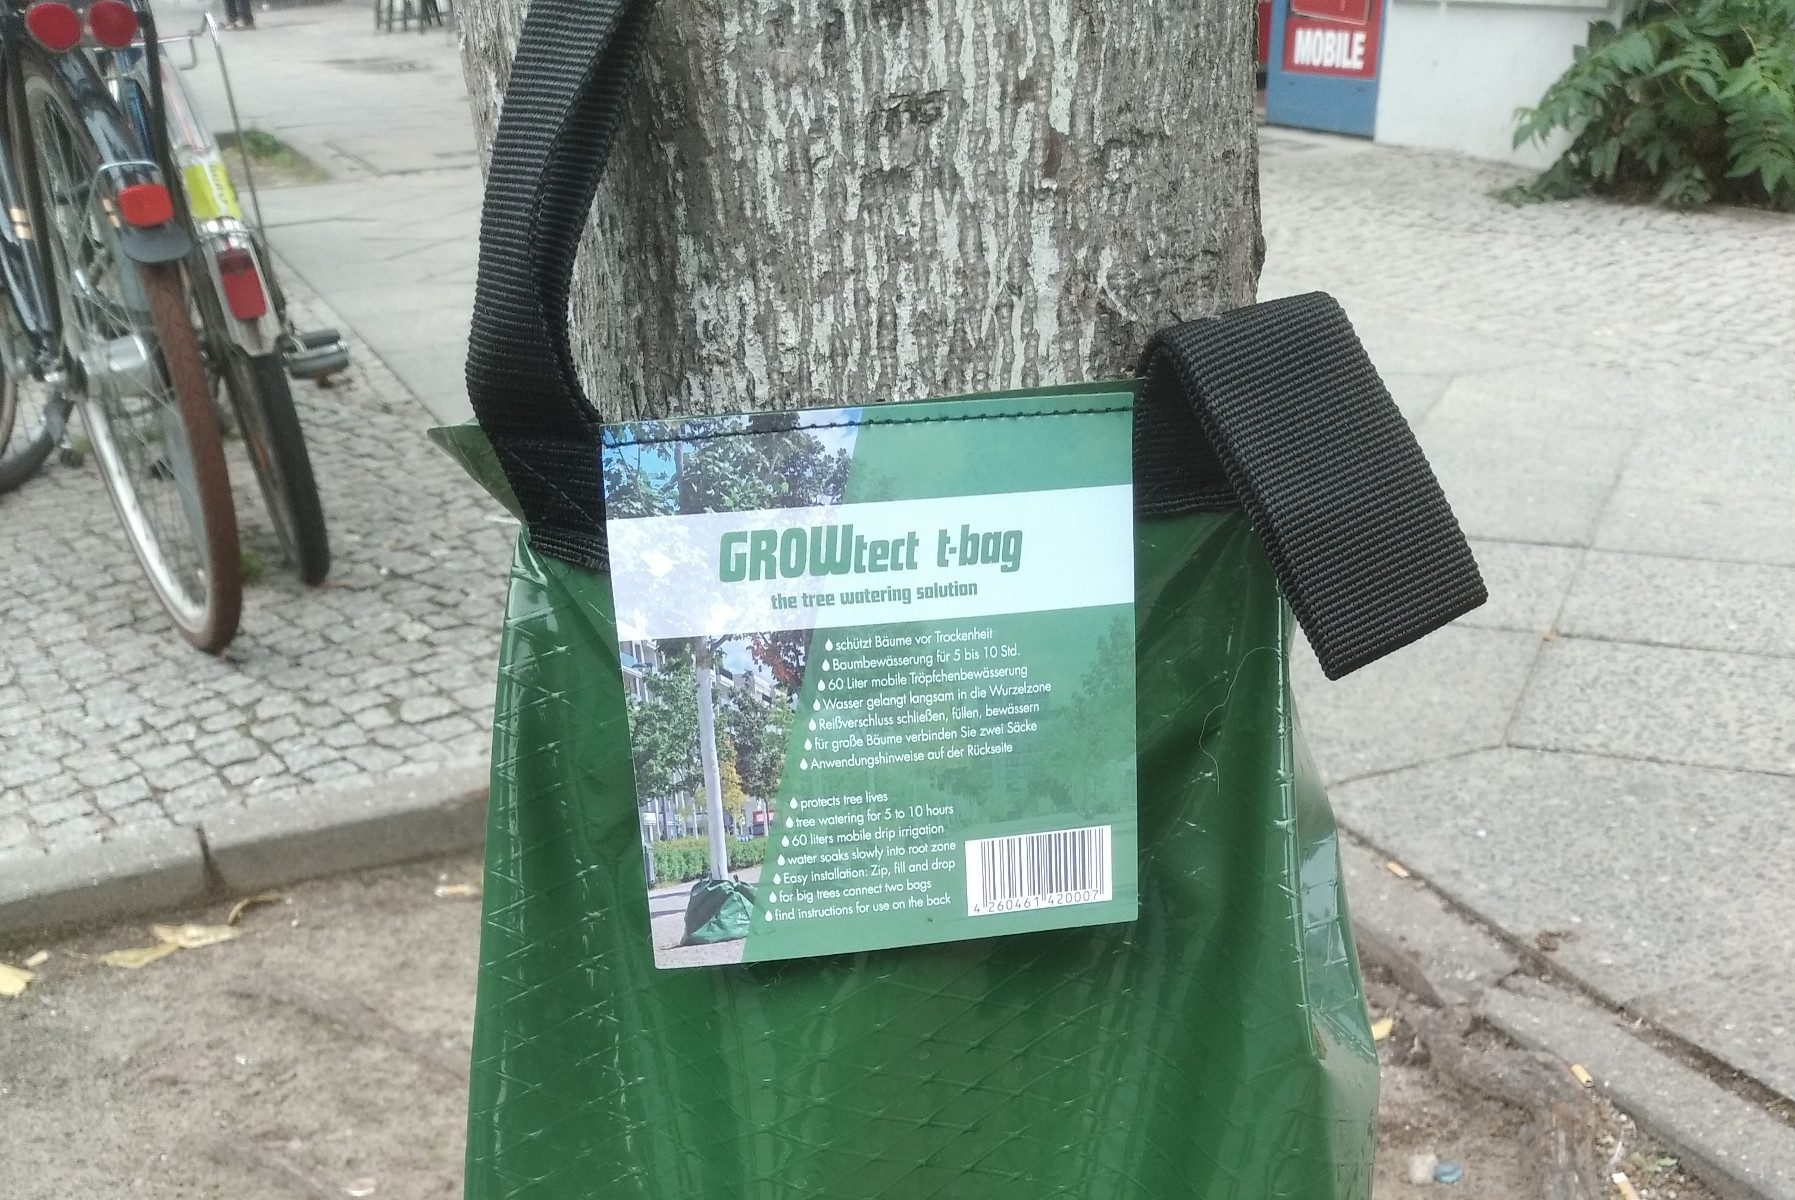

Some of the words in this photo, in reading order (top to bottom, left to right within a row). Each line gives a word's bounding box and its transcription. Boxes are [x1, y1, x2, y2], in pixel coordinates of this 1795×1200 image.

[1294, 28, 1367, 70] MOBILE
[719, 524, 920, 583] GROWtect
[937, 524, 1023, 573] t-bag
[771, 593, 798, 610] the
[802, 592, 835, 608] tree
[840, 586, 912, 606] watering
[917, 581, 978, 600] solution
[835, 635, 873, 651] schützt
[874, 634, 913, 648] Bäume
[914, 634, 933, 645] vor
[933, 627, 993, 644] Trockenheit
[832, 654, 934, 671] Baumbewässerung
[935, 648, 951, 663] für
[952, 647, 961, 662] 5
[963, 646, 980, 661] bis
[983, 644, 998, 659] 10
[1000, 642, 1020, 658] Std.
[827, 676, 844, 691] 60
[846, 676, 868, 690] Liter
[871, 671, 907, 687] mobile
[908, 665, 1028, 687] Tröpfchenbewässerung
[822, 697, 864, 712] Wasser
[866, 692, 907, 711] gelangt
[909, 690, 955, 707] langsam
[957, 688, 968, 700] in
[969, 684, 987, 699] die
[988, 680, 1052, 697] Wurzelzone
[818, 712, 894, 731] Reißverschluss
[896, 707, 949, 725] schließen,
[951, 705, 982, 720] füllen,
[985, 702, 1040, 717] bewässern
[813, 735, 829, 751] für
[830, 733, 864, 753] große
[865, 733, 903, 746] Bäume
[904, 726, 958, 743] verbinden
[960, 725, 977, 739] Sie
[979, 722, 1004, 737] zwei
[1006, 718, 1038, 734] Säcke
[809, 750, 925, 770] Anwendungshinweise
[926, 745, 945, 761] auf
[946, 744, 965, 759] der
[966, 741, 1013, 757] Rückseite
[799, 795, 841, 812] protects
[842, 794, 863, 805] tree
[865, 789, 889, 803] lives
[795, 816, 816, 828] tree
[817, 811, 865, 826] watering
[866, 807, 882, 822] for
[883, 807, 892, 821] 5
[894, 808, 905, 819] to
[908, 804, 923, 818] 10
[925, 803, 954, 817] hours
[791, 833, 808, 847] 60
[809, 831, 834, 845] liters
[836, 827, 872, 843] mobile
[873, 825, 896, 842] drip
[898, 823, 944, 840] irrigation
[786, 853, 818, 865] water
[819, 848, 850, 863] soaks
[851, 844, 884, 861] slowly
[886, 845, 906, 857] into
[907, 842, 929, 855] root
[930, 841, 957, 853] zone
[782, 871, 808, 887] Easy
[810, 866, 868, 882] installation:
[870, 863, 891, 879] Zip,
[893, 860, 906, 874] fill
[907, 857, 929, 873] and
[930, 856, 956, 872] drop
[778, 889, 794, 903] for
[795, 888, 814, 904] big
[815, 889, 841, 900] trees
[842, 883, 883, 897] connect
[883, 882, 904, 893] two
[905, 877, 932, 893] bags
[973, 903, 981, 914] 4
[988, 896, 1039, 912] 260461
[1048, 889, 1099, 905] 420007
[774, 906, 796, 921] find
[797, 904, 854, 919] instructions
[855, 900, 870, 914] for
[872, 902, 890, 912] use
[891, 900, 906, 910] on
[907, 895, 924, 908] the
[925, 891, 951, 906] back
